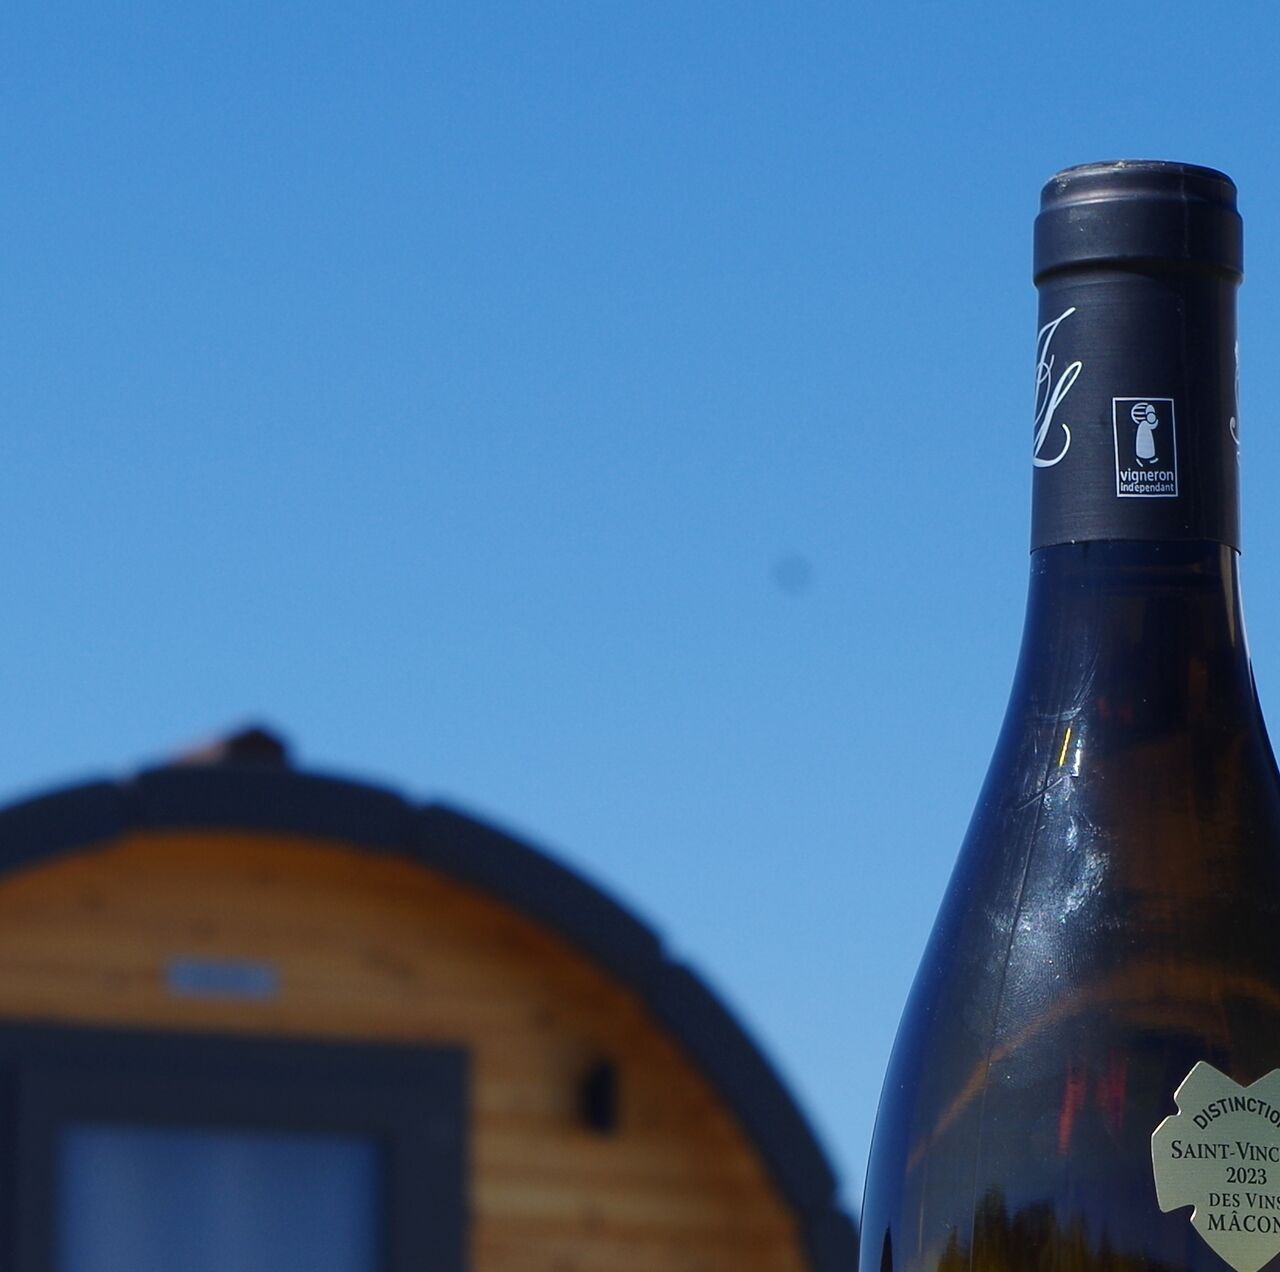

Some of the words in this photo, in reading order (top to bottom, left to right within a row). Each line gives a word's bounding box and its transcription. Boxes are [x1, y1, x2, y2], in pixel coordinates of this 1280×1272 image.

[1120, 468, 1174, 484] vigneron
[1226, 1167, 1267, 1185] 2023
[1209, 1193, 1240, 1208] DES
